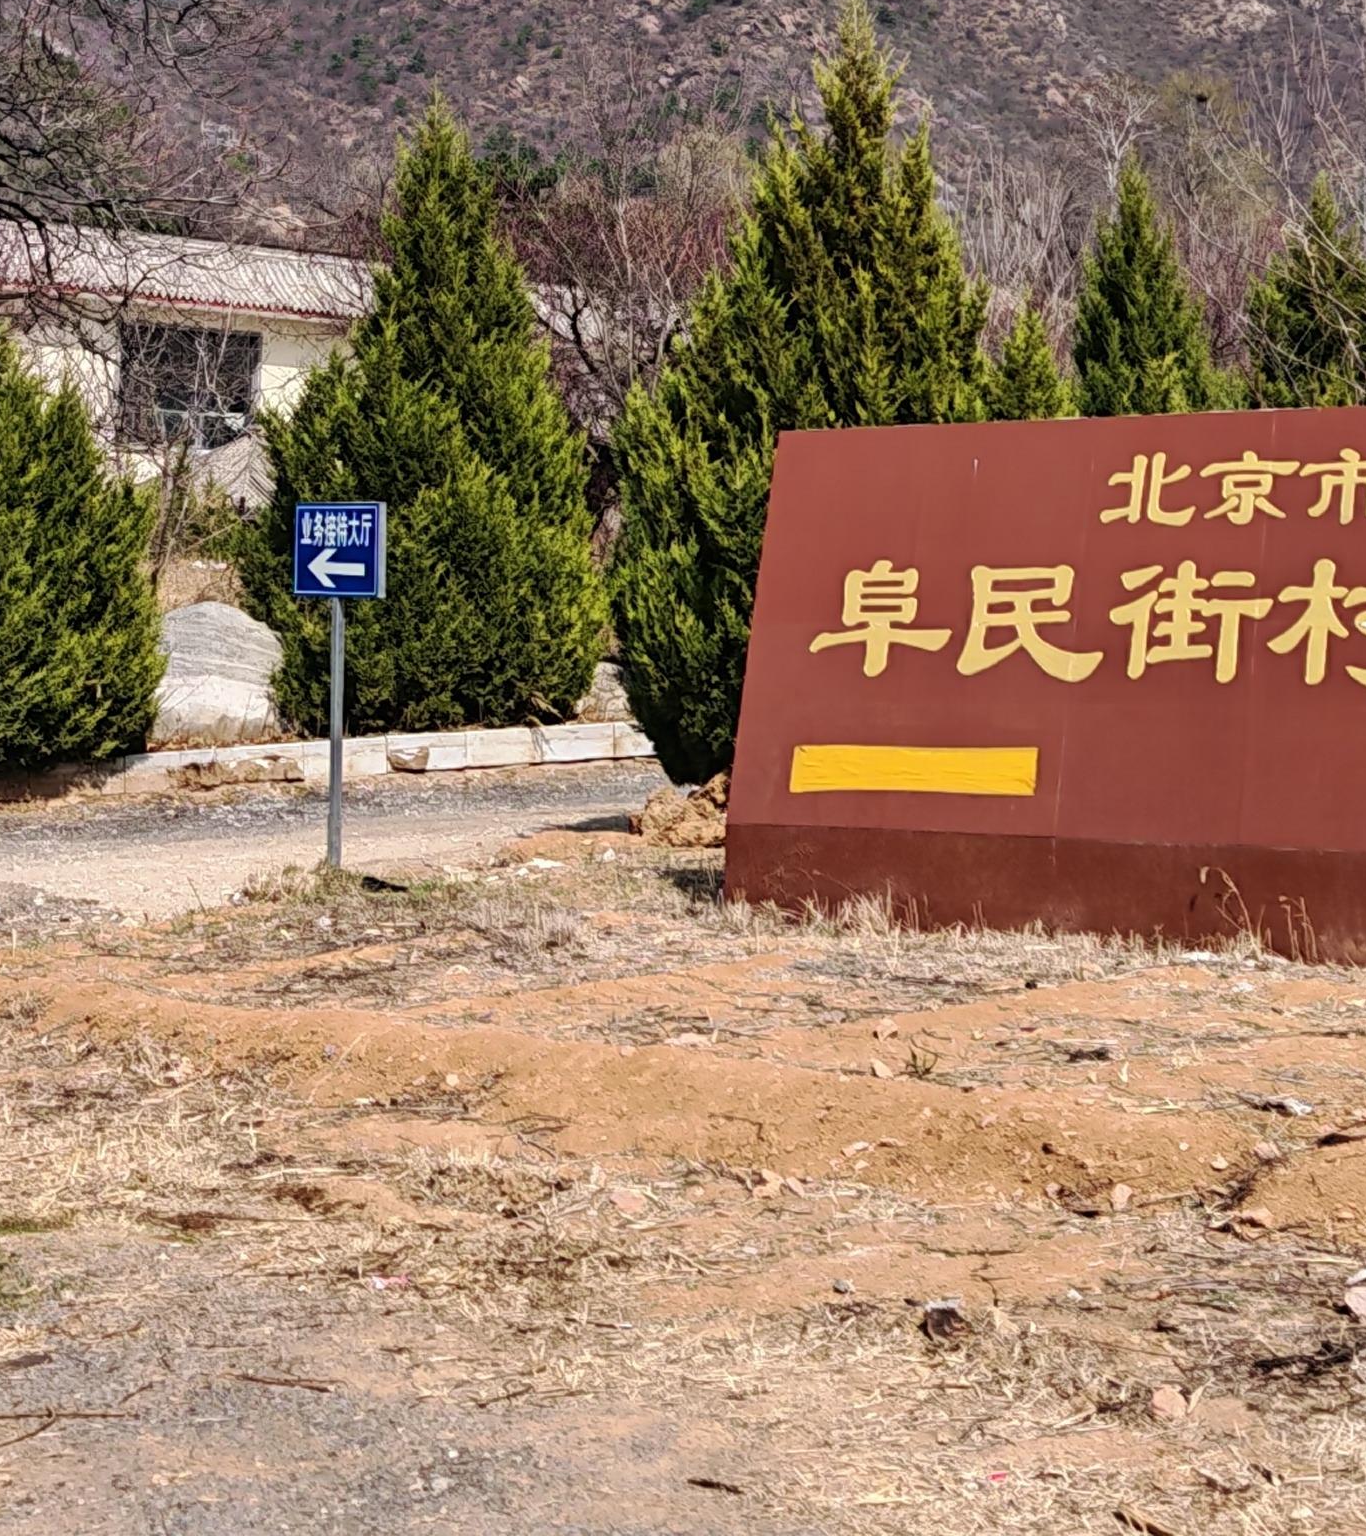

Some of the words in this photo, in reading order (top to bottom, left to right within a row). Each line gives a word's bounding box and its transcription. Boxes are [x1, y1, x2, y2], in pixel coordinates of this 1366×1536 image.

[300, 511, 373, 547] 业务接待大厅
